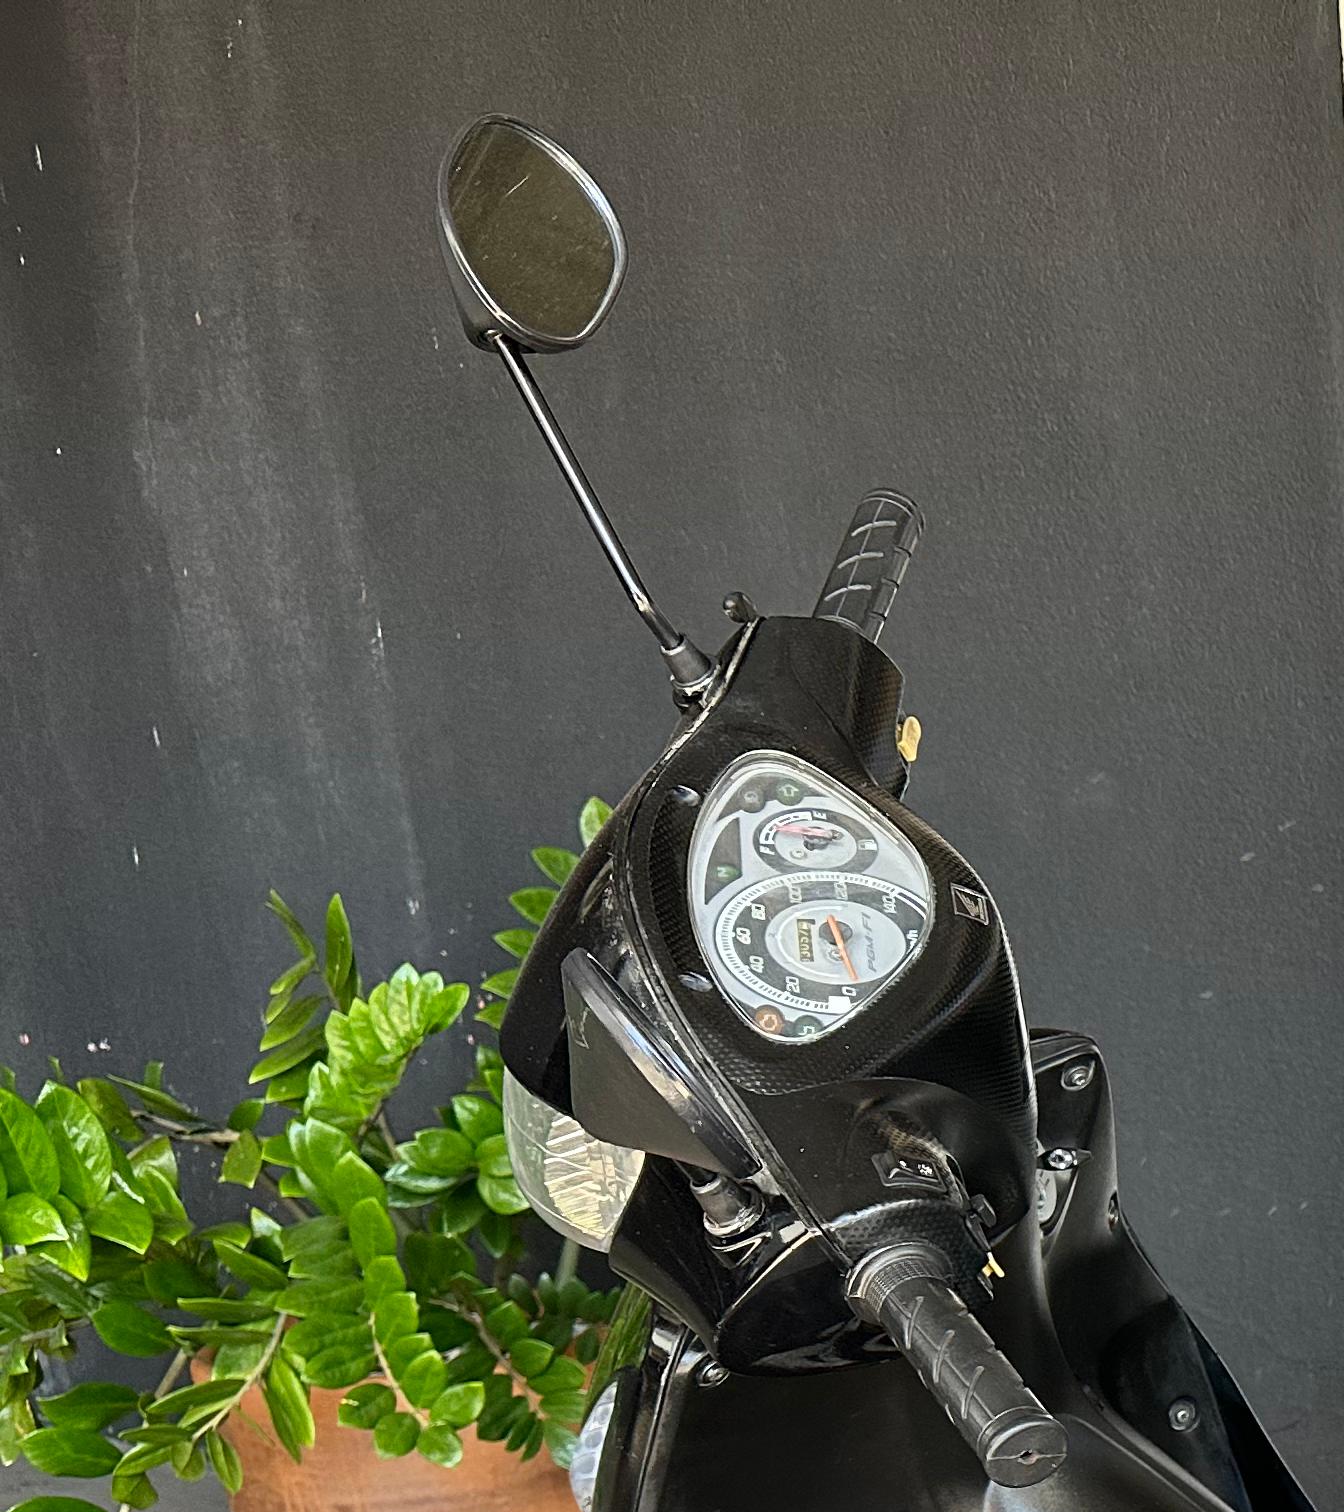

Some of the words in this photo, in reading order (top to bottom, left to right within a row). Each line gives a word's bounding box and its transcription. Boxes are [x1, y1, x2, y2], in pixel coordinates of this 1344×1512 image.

[736, 927, 751, 944] 60
[749, 955, 764, 974] 40
[785, 975, 800, 993] 20
[841, 986, 857, 997] 0
